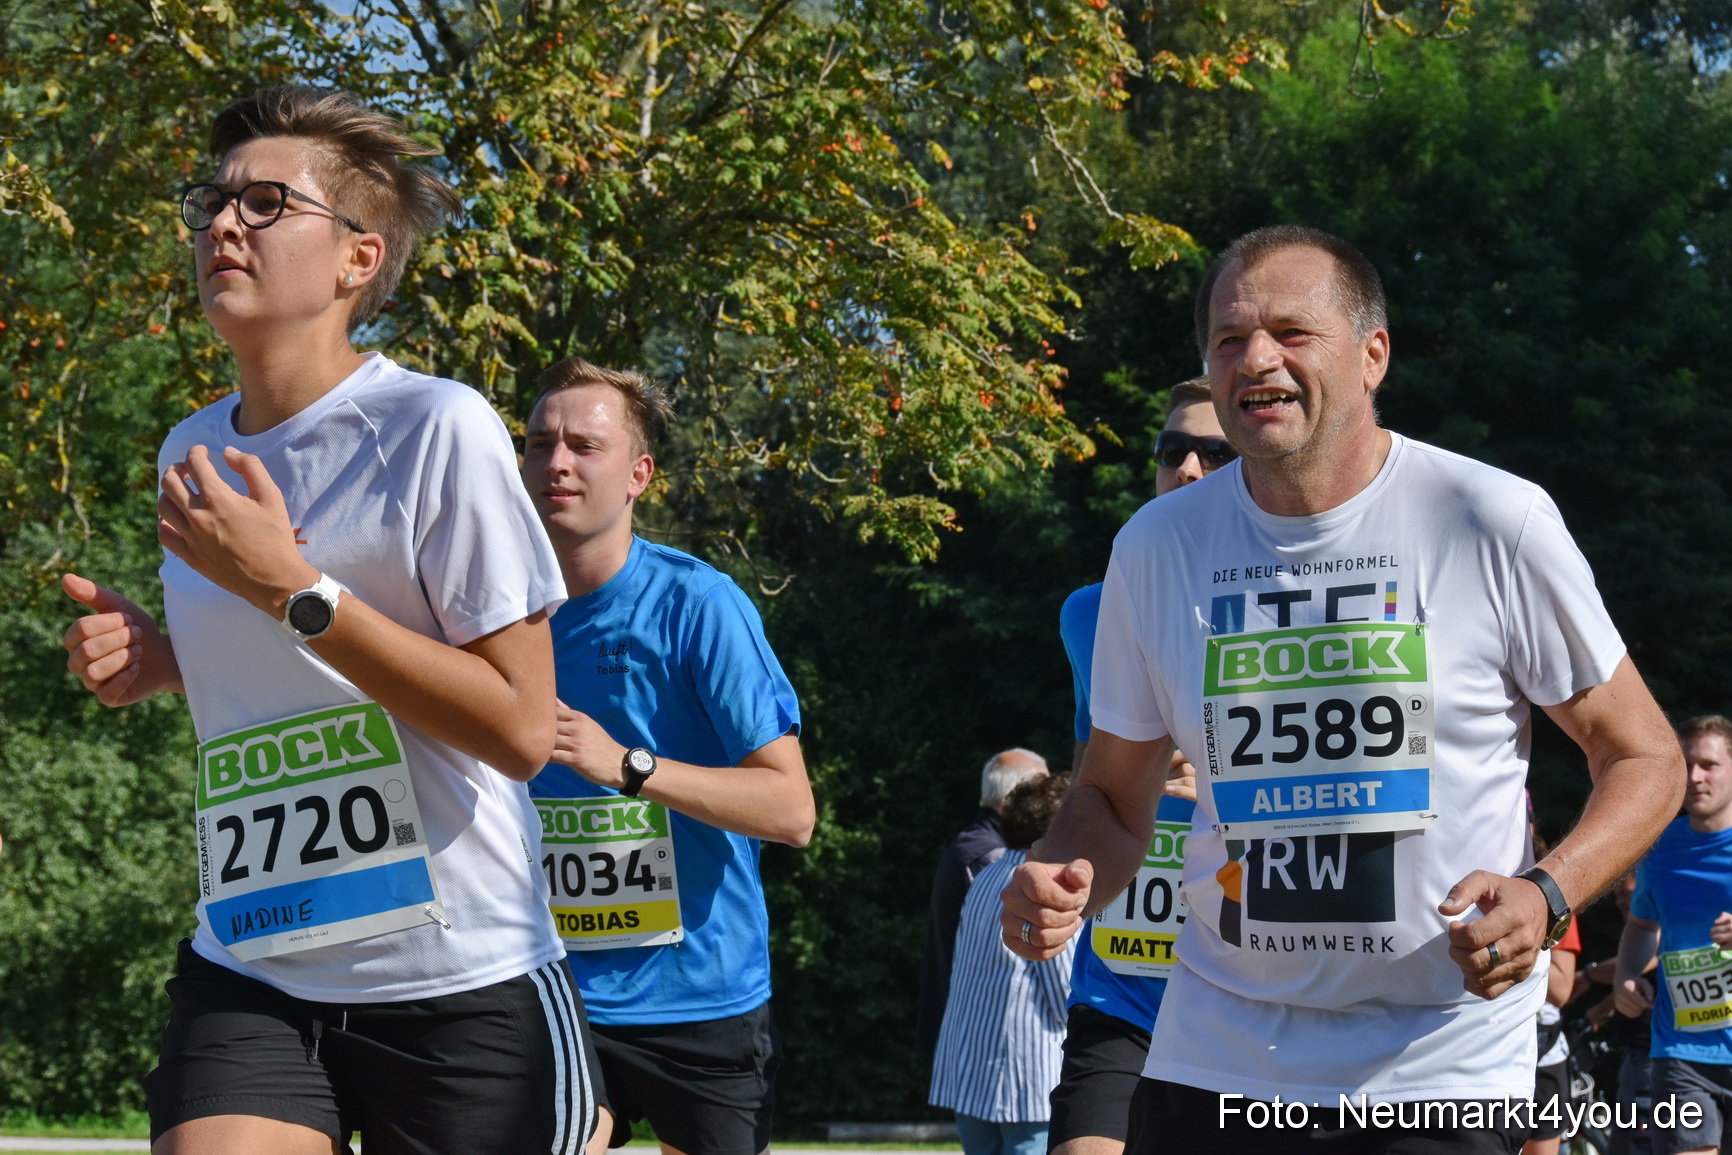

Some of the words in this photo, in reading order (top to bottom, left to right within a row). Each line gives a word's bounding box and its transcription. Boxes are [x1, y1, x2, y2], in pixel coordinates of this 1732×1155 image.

[1213, 568, 1238, 584] DIE
[1245, 565, 1284, 580] NEUE
[1291, 555, 1399, 577] WOHNFORMEL
[596, 664, 630, 676] Tobias
[1219, 632, 1407, 686] BOCK
[1227, 695, 1405, 767] 2589
[1411, 700, 1422, 711] D
[207, 714, 379, 796] BOCK
[1252, 781, 1383, 814] ALBERT
[216, 785, 390, 885] 2720
[541, 802, 652, 837] BOCK
[542, 849, 657, 897] 1034
[658, 850, 666, 859] D
[1262, 833, 1349, 890] RW
[231, 898, 315, 941] NADINE
[556, 910, 641, 932] TOBIAS
[1109, 935, 1177, 960] MATT
[1250, 934, 1395, 953] RAUMWERK
